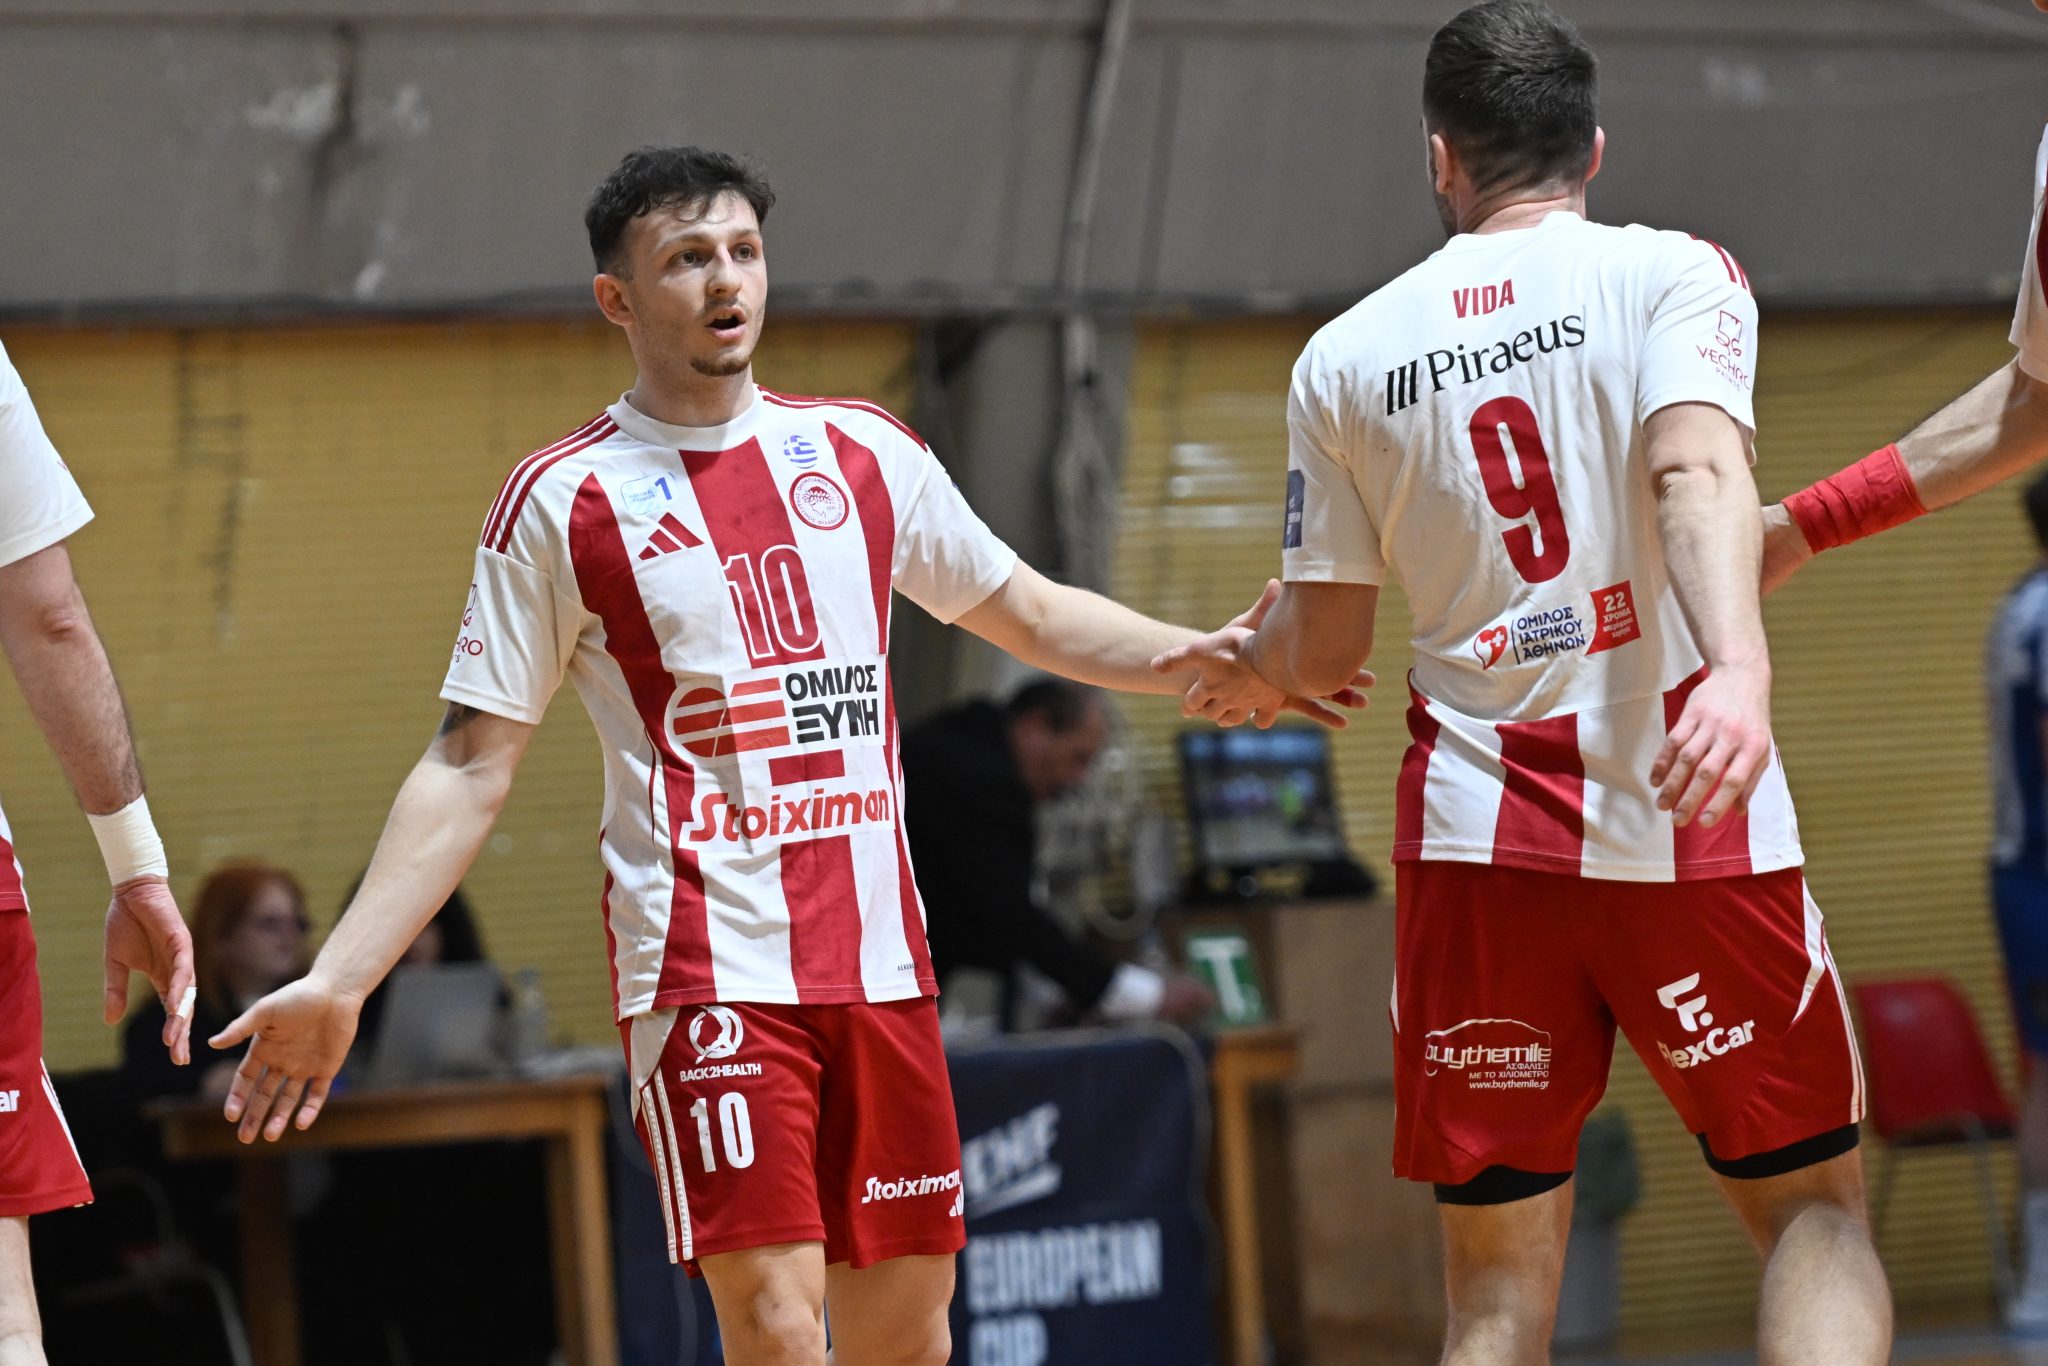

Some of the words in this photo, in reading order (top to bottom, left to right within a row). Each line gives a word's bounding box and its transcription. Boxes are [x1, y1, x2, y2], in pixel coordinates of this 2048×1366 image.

[1453, 279, 1515, 319] VIDA
[1424, 314, 1586, 394] Piraeus
[654, 476, 673, 501] 1
[1469, 395, 1571, 584] 9
[722, 544, 824, 660] 10
[1603, 591, 1626, 613] 22
[1517, 606, 1574, 631] ΟΜΙΛΟΣ
[1519, 619, 1583, 646] ΙΑΤΡΙΚΟΥ
[1523, 634, 1586, 661] ΑΘΗΝΩΝ
[688, 787, 890, 843] Stoiximan
[680, 1063, 762, 1083] BACK2HEALTH
[1468, 1071, 1483, 1080] ΜΕ
[1484, 1071, 1497, 1079] ΤΟ
[1468, 1079, 1550, 1091] www.buythemile.gr
[689, 1091, 755, 1174] 10
